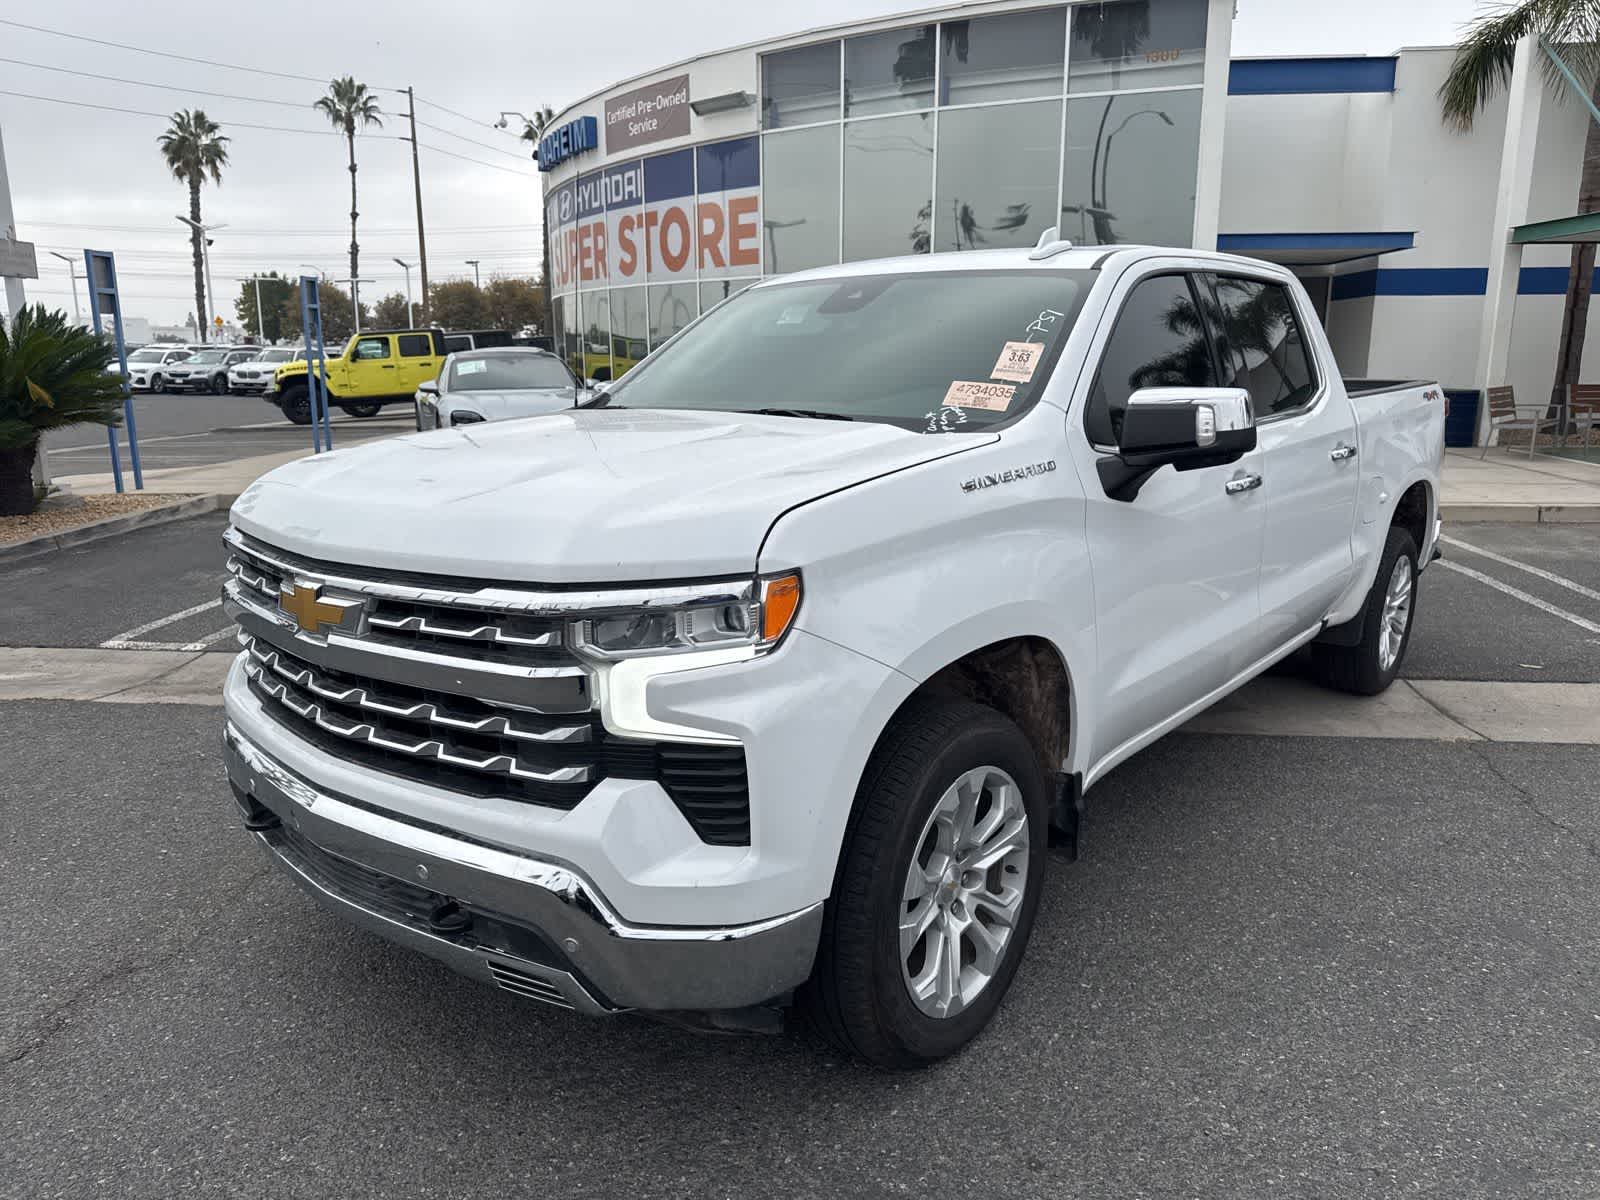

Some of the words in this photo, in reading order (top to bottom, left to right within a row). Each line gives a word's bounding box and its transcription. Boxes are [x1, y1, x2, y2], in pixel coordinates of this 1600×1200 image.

[607, 102, 637, 125] Certified
[637, 88, 687, 115] Pre-Owned
[628, 117, 658, 136] Service
[577, 168, 642, 206] HYUNDAI
[618, 196, 760, 277] STORE
[956, 384, 1013, 399] 4734035
[961, 460, 1056, 493] SILVERADO
